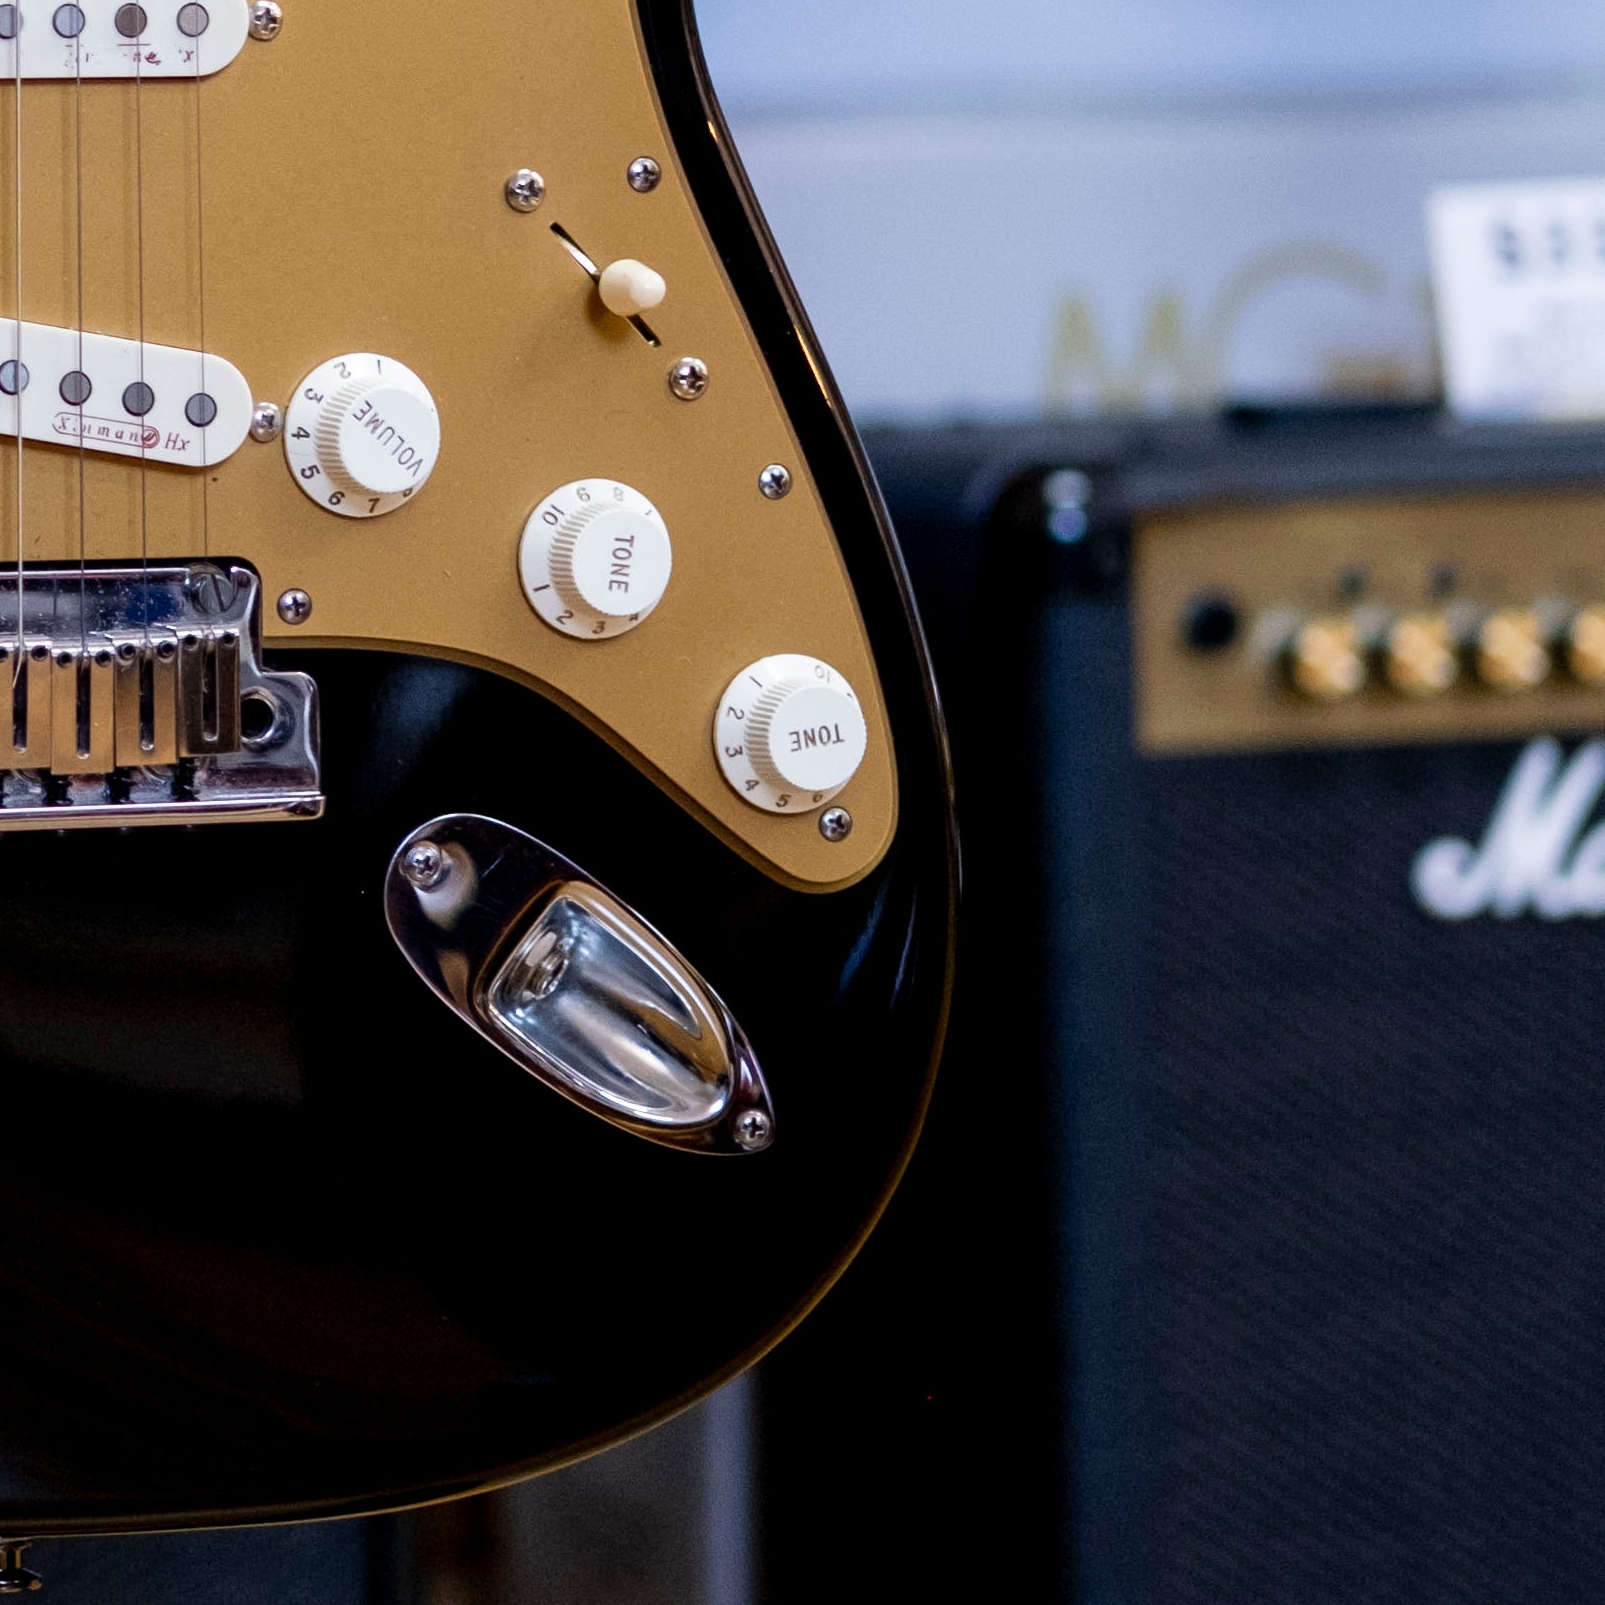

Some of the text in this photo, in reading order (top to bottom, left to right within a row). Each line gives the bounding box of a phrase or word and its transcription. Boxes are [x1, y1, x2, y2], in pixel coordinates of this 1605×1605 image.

[333, 361, 351, 380] 2
[304, 388, 324, 405] 3
[291, 426, 311, 441] 4
[352, 399, 424, 477] VOLUME
[300, 464, 321, 479] 5
[328, 490, 346, 506] 6
[368, 497, 381, 513] 7
[542, 504, 565, 526] 10
[555, 609, 574, 626] 2
[591, 620, 606, 635] 3
[608, 535, 635, 594] TONE
[726, 706, 745, 721] 2
[788, 723, 845, 753] TONE
[725, 745, 744, 758] 3
[744, 778, 761, 792] 4
[775, 793, 792, 808] 5
